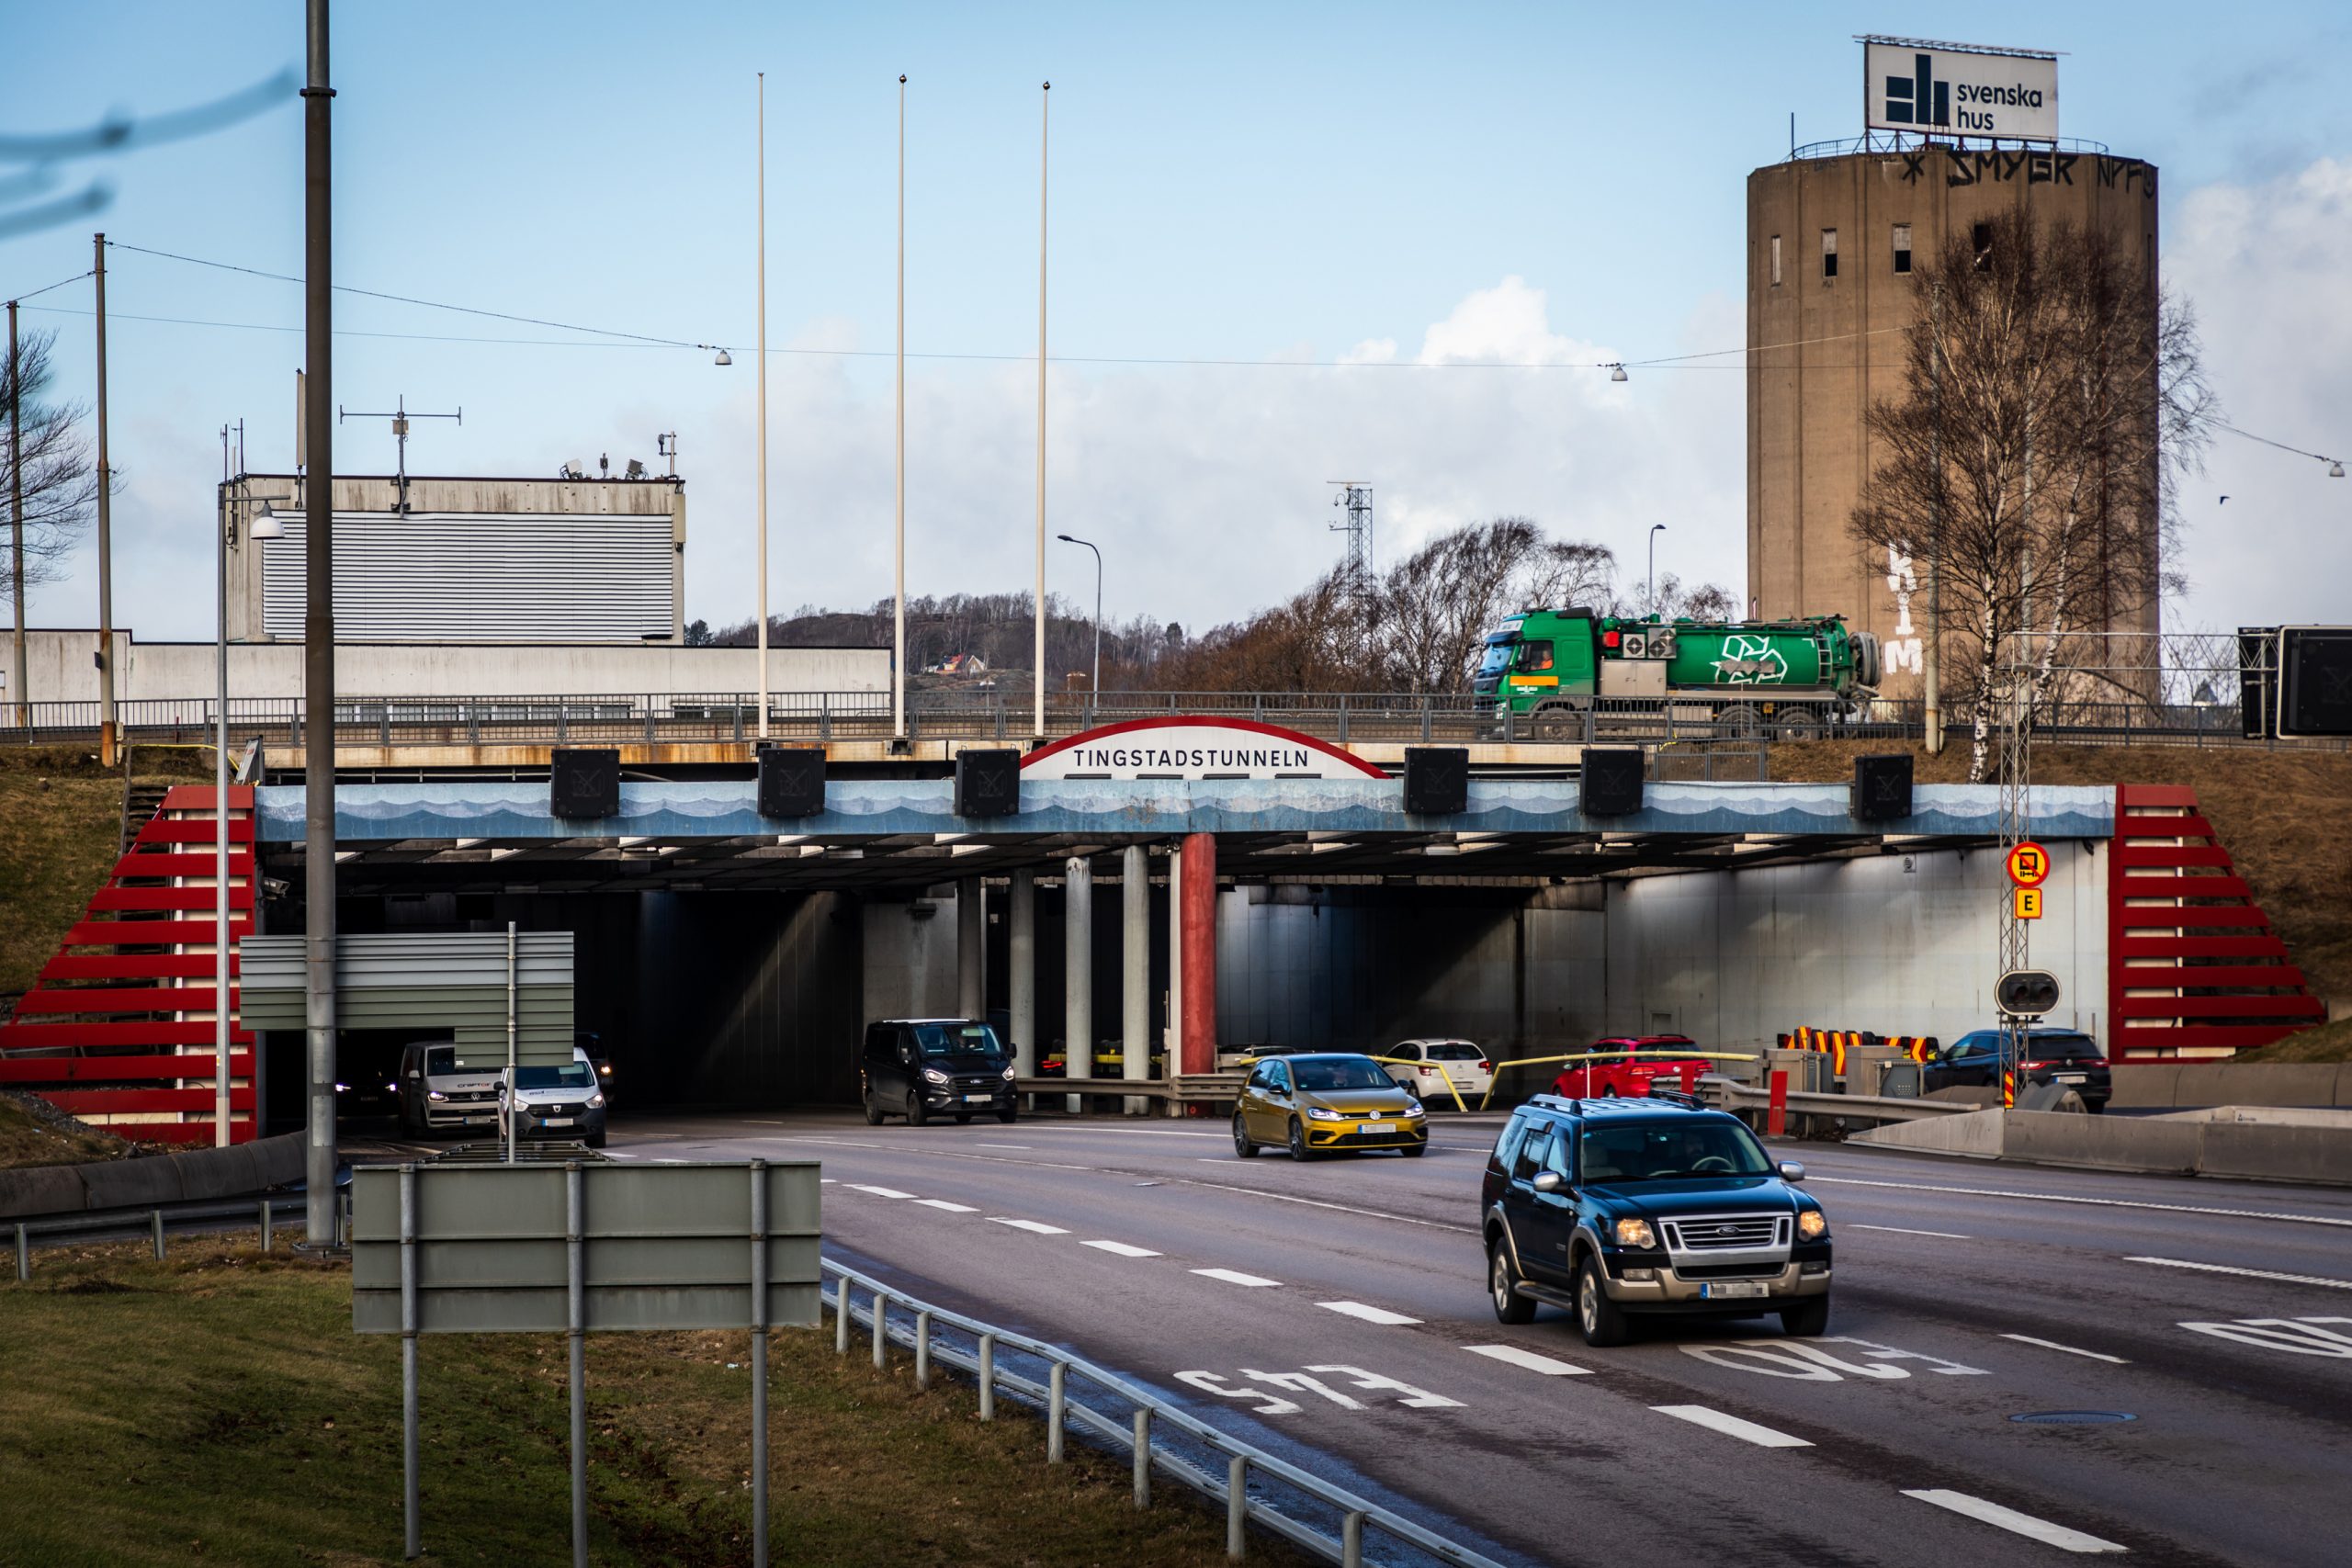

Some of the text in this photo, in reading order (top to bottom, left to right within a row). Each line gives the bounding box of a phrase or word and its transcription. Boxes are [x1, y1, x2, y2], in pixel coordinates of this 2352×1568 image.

[1957, 83, 2042, 108] svenska
[1957, 105, 1994, 130] hus
[1073, 750, 1308, 768] TINGSTADSTUNNELN
[2024, 895, 2033, 911] E
